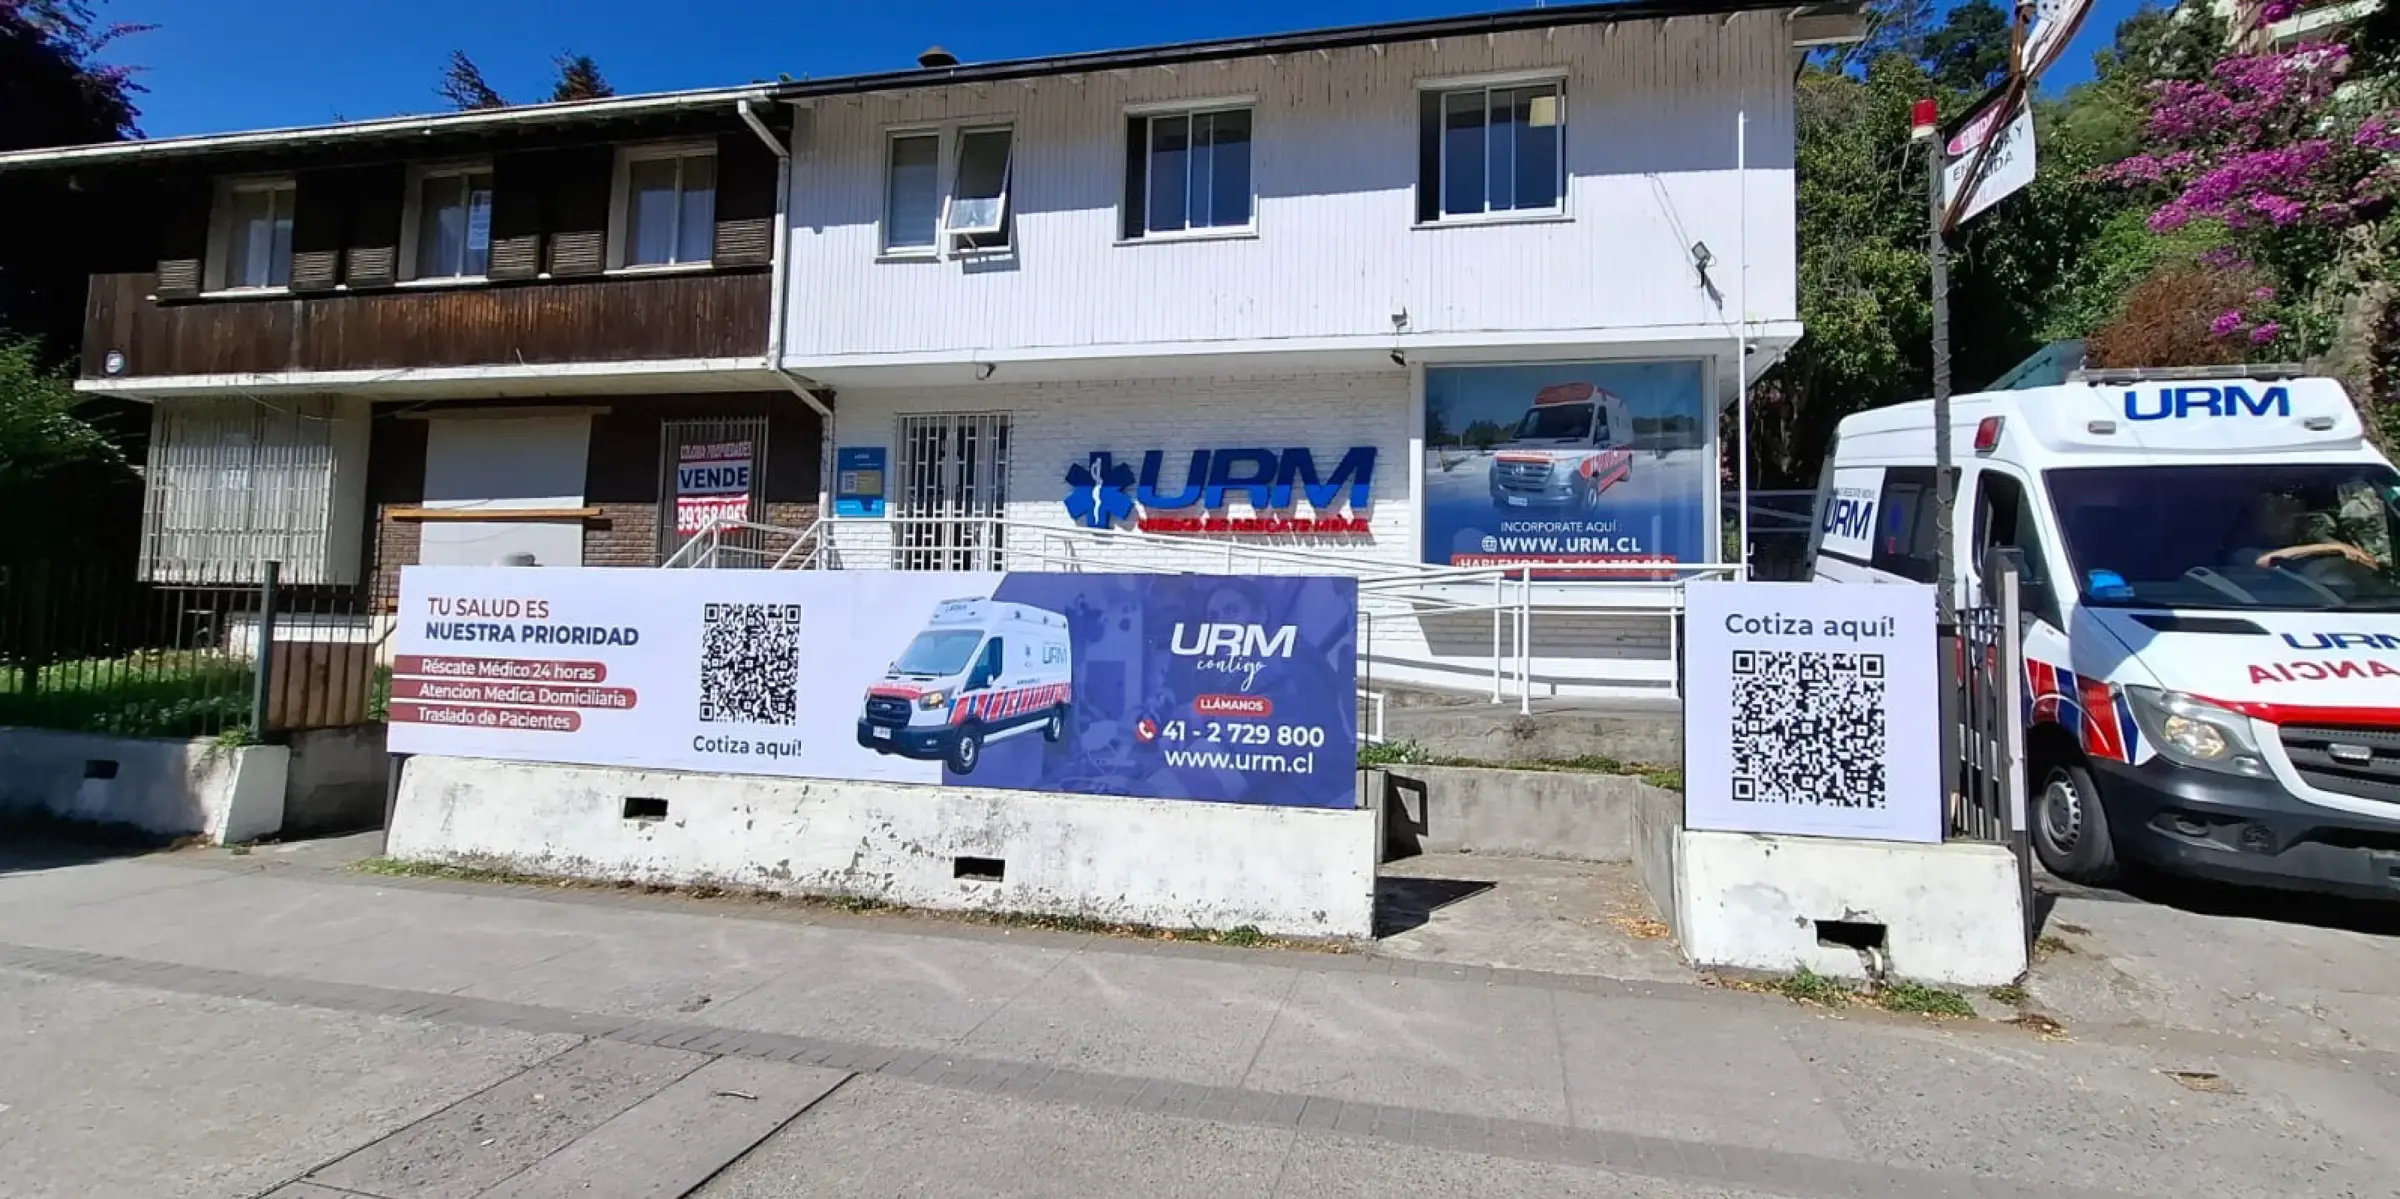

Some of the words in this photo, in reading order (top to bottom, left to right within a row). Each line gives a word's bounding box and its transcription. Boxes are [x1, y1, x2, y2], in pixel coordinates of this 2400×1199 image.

[2124, 386, 2290, 421] URM
[680, 467, 749, 488] VENDE
[1137, 446, 1378, 510] URM
[1501, 521, 1582, 533] INCORPORATE
[1822, 498, 1873, 540] URM
[1500, 536, 1641, 552] WWW.URM.CL
[428, 597, 451, 616] TU
[456, 598, 520, 617] SALUD
[526, 600, 549, 618] ES
[426, 622, 515, 643] NUESTRA
[522, 625, 639, 646] PRIORIDAD
[1724, 612, 1814, 636] Cotiza
[1823, 615, 1895, 642] aquí!
[1171, 622, 1297, 658] URM
[421, 658, 475, 676] Réscate
[478, 660, 530, 678] Médico
[532, 663, 551, 678] 24
[554, 664, 596, 680] horas
[1196, 652, 1268, 692] contigo
[419, 683, 481, 701] Atencion
[539, 688, 626, 707] Domiciliaria
[1200, 698, 1264, 712] LLÁMANOS
[418, 707, 474, 724] Traslado
[477, 709, 497, 725] de
[500, 711, 570, 730] Pacientes
[1162, 720, 1186, 741] 41
[1207, 721, 1221, 743] 2
[1227, 723, 1270, 745] 729
[1277, 725, 1325, 748] 800
[693, 735, 749, 754] Cotiza
[755, 738, 802, 760] aquí!
[1165, 750, 1313, 774] www.urm.cl
